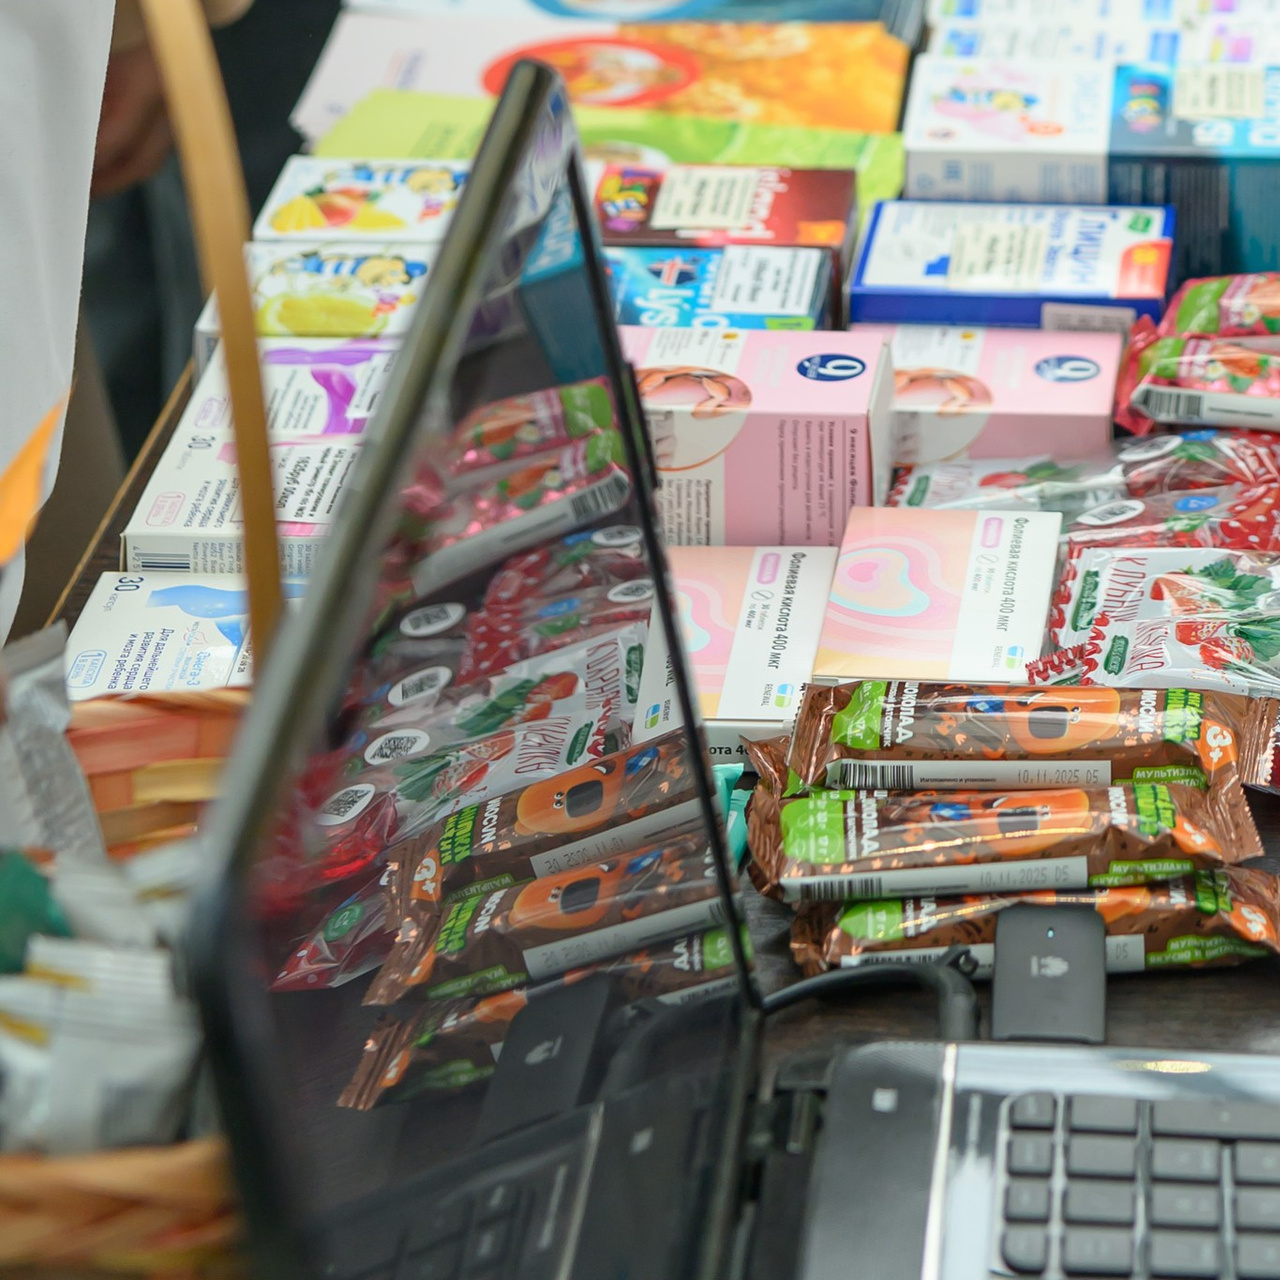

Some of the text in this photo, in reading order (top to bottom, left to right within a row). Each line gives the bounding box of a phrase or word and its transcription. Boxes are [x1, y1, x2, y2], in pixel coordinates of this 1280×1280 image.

[188, 435, 216, 449] 30
[114, 576, 144, 592] 30
[996, 517, 1029, 632] Фолиевая кислота 400 мкг
[768, 552, 807, 669] Фолиевая кислота 400 мкг
[122, 638, 134, 659] мозга
[140, 628, 175, 690] Для дальнейшего
[991, 645, 1003, 669] RENEWAL
[123, 632, 155, 690] развития сердца
[108, 657, 127, 690] ребенка
[761, 683, 774, 708] RENEWAL
[1017, 769, 1080, 784] 10.11.2025
[980, 868, 1048, 887] 10.11.2025
